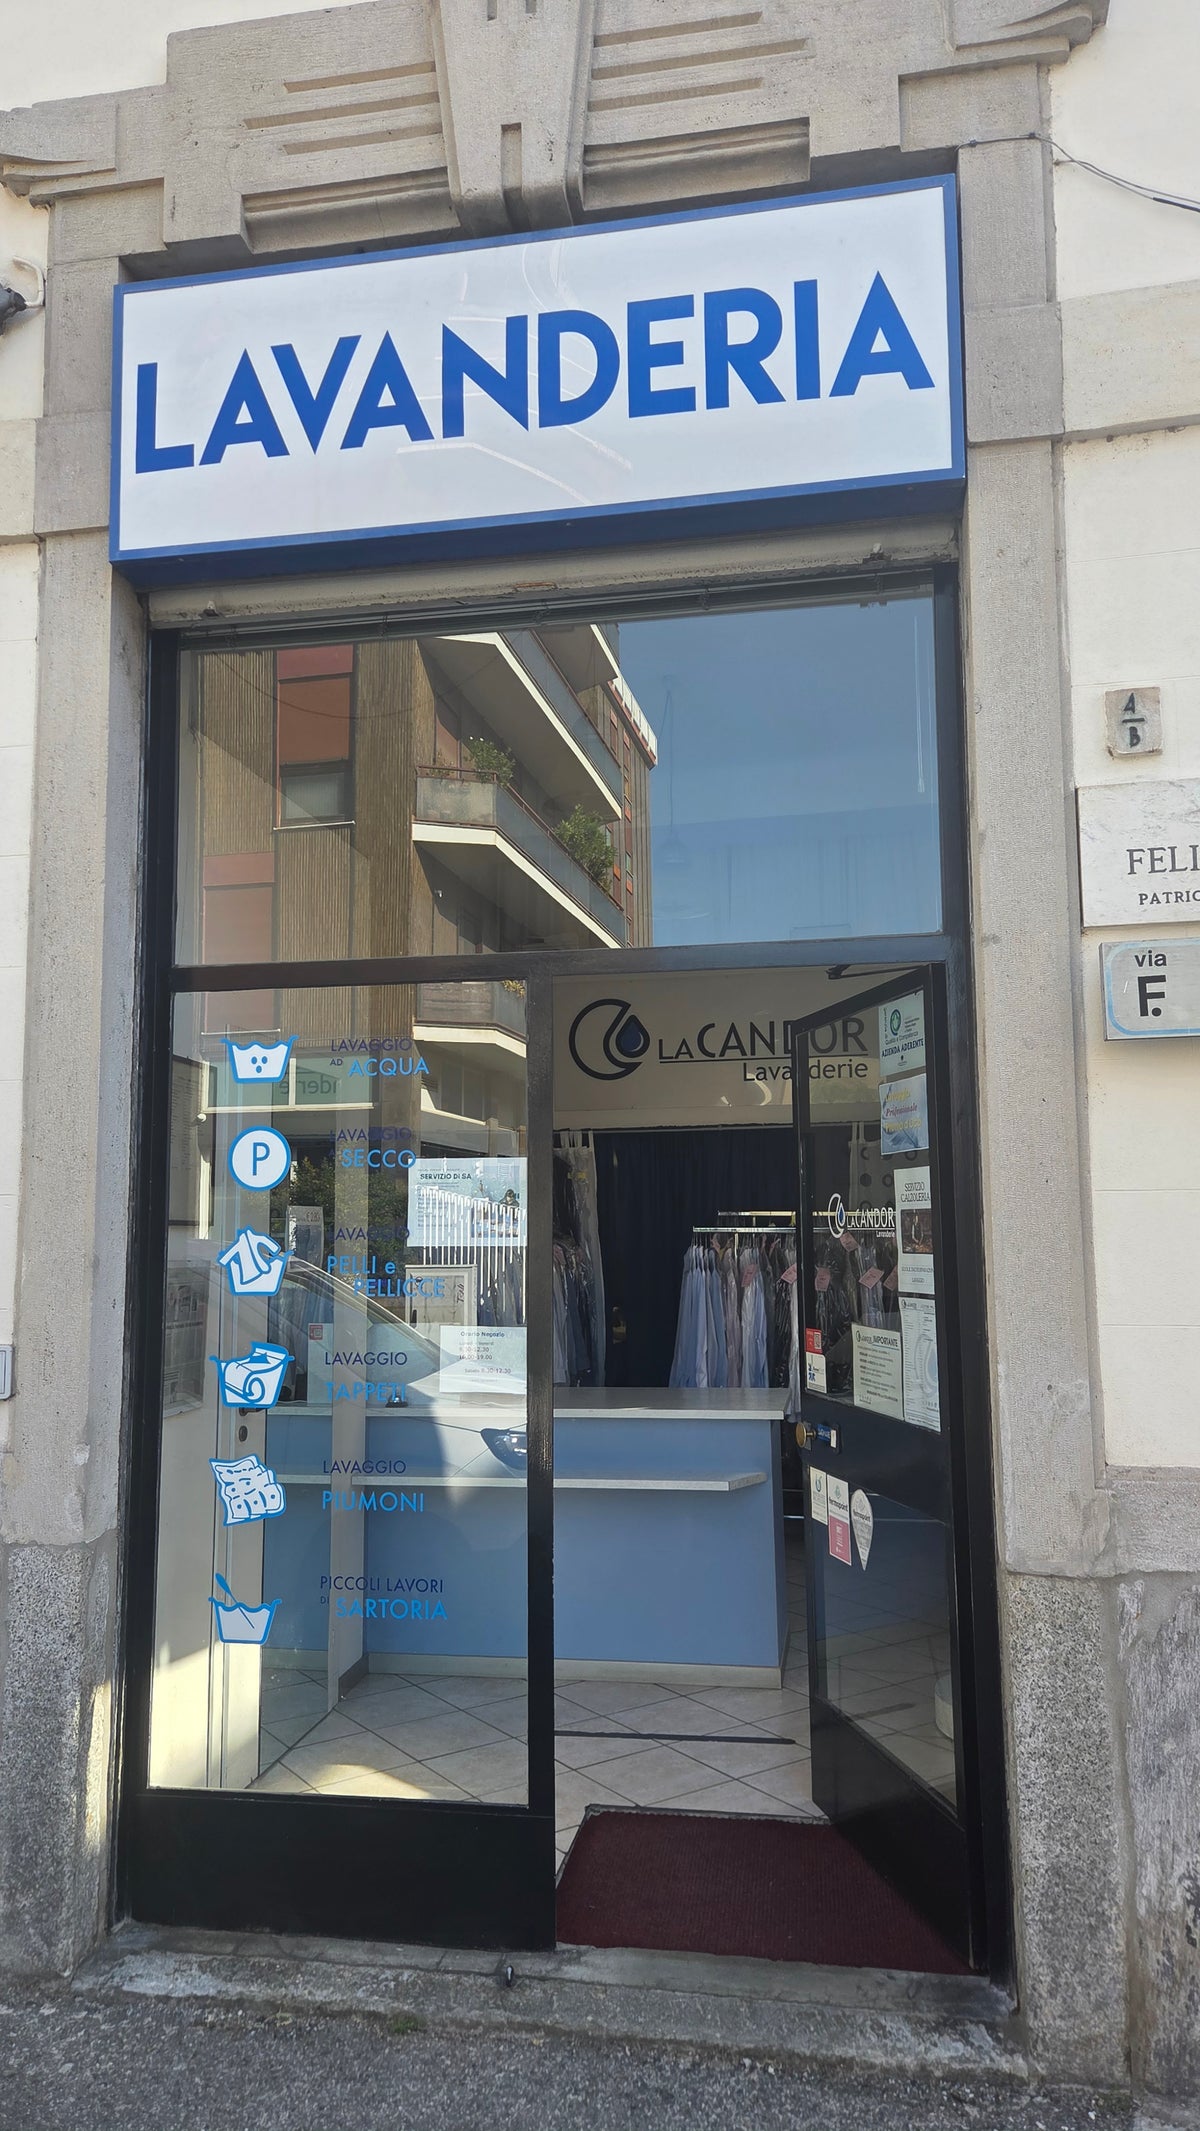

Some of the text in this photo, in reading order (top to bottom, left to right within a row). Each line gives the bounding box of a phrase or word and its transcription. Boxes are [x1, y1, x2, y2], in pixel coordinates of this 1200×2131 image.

[136, 271, 934, 473] LAVANDERIA
[1123, 693, 1136, 714] A
[1128, 726, 1141, 748] B
[1126, 845, 1200, 875] FELI
[1134, 950, 1167, 967] via
[1138, 975, 1166, 1016] F.
[331, 1038, 412, 1051] LAVAGGIO
[348, 1057, 429, 1077] ACQUA
[743, 1059, 868, 1081] Lavaderie
[340, 1148, 416, 1168] SECCO
[327, 1255, 396, 1274] PELLI e
[353, 1278, 445, 1297] PELLICCE
[325, 1351, 407, 1365] LAVAGGIO
[324, 1381, 407, 1402] TAPPETI
[323, 1460, 407, 1474] LAVAGGIO
[322, 1490, 424, 1512] PIUMONI
[320, 1575, 443, 1593] PICCOLI LAVORI
[335, 1597, 447, 1620] SARTORIA
